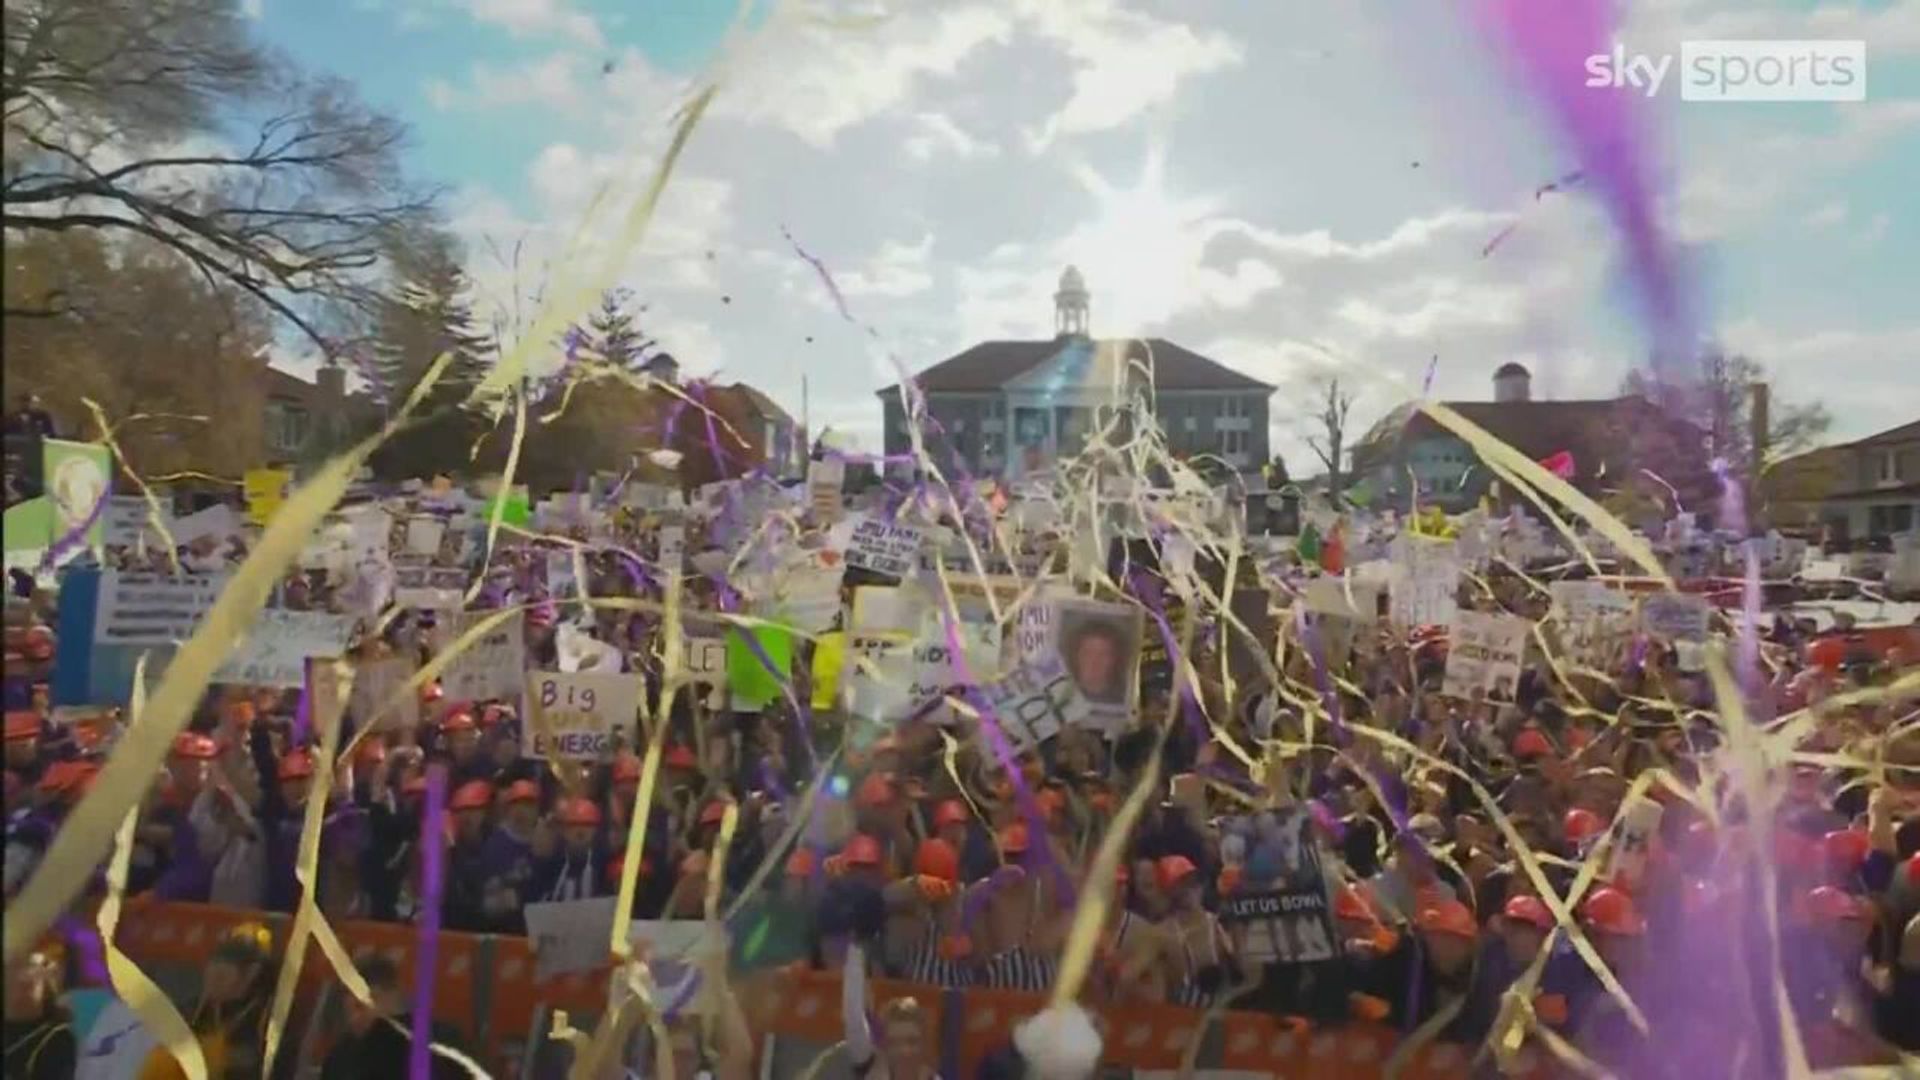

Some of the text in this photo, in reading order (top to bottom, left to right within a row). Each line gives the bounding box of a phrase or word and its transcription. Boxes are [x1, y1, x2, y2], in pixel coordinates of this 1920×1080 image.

[542, 680, 596, 712] Big
[1233, 893, 1327, 916] LET US BOWL
